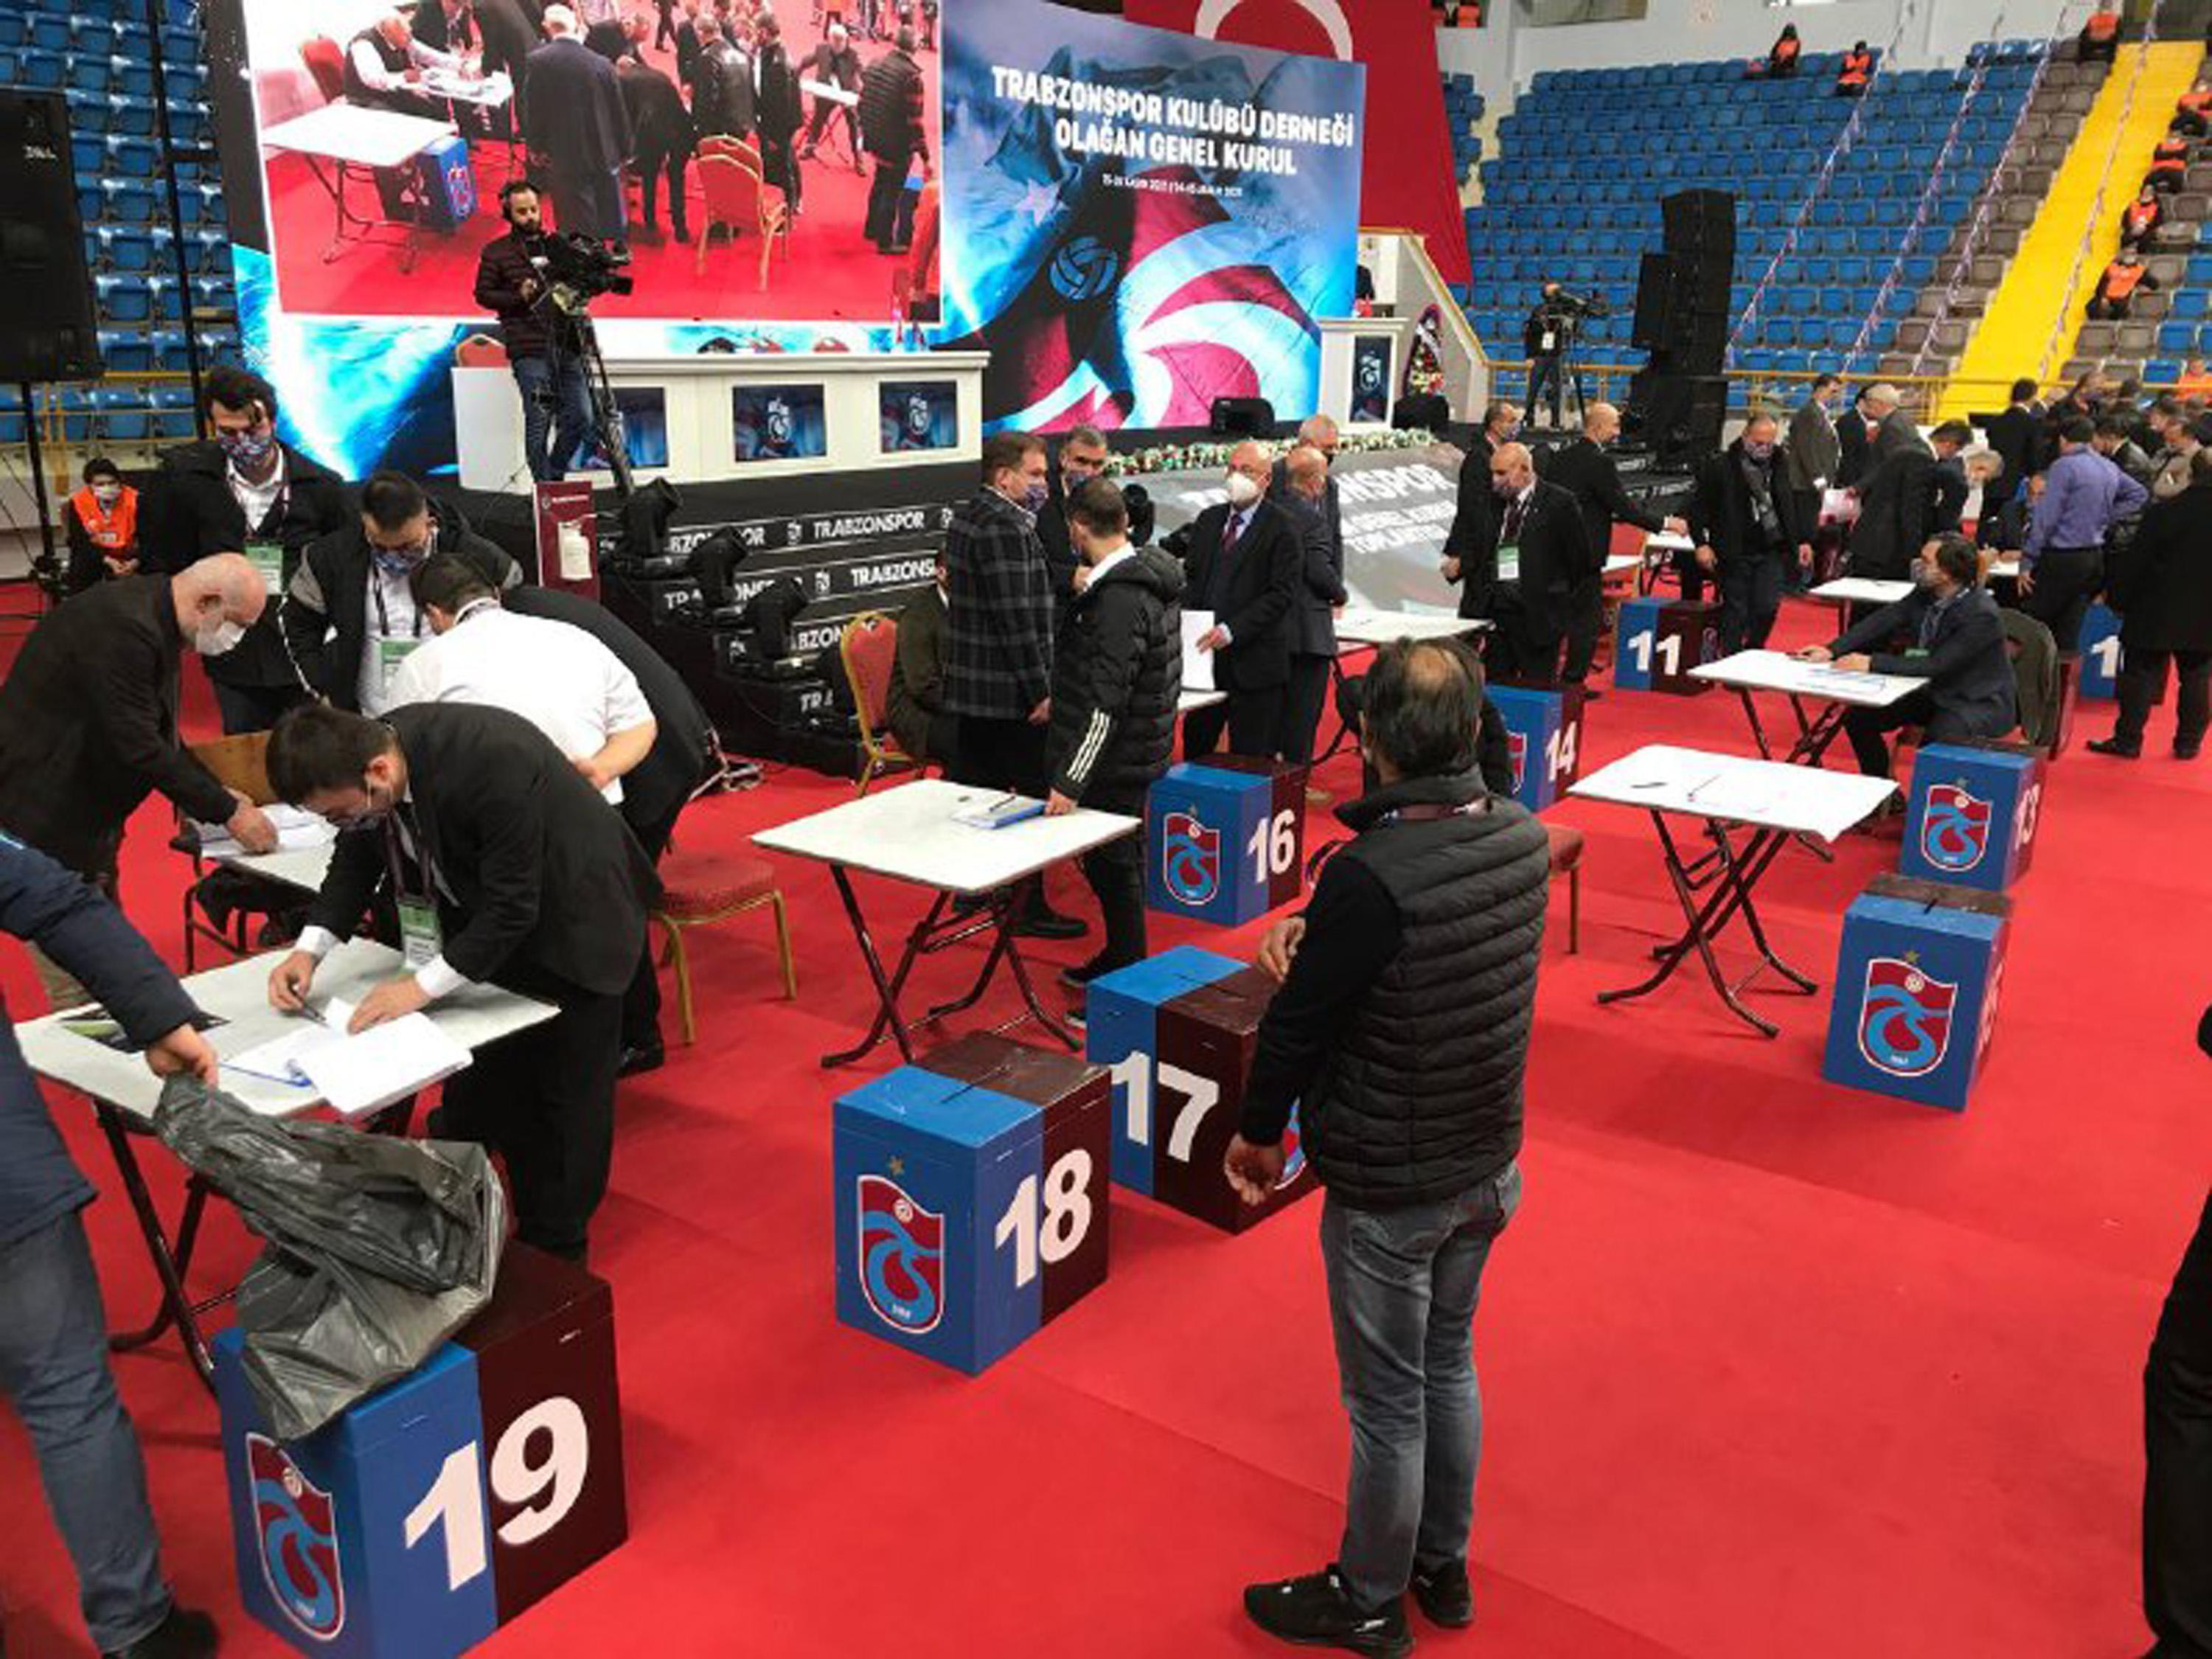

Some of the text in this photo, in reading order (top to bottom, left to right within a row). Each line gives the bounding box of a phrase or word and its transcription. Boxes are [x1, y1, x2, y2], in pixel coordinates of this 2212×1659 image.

[991, 66, 1163, 125] TRABZONSPOR
[1259, 110, 1354, 147] DERNEĞİ
[1055, 118, 1298, 176] OLAĞAN GENEL KURUL
[813, 512, 925, 539] TRABZONSPOR
[850, 558, 936, 588] TRABZONS
[1627, 630, 1682, 676] 11
[2090, 635, 2124, 677] 1
[1544, 720, 1577, 782] 14
[1246, 808, 1296, 884] 16
[1110, 1050, 1221, 1164] 17
[995, 1149, 1093, 1290] 18
[403, 1396, 589, 1592] 19
